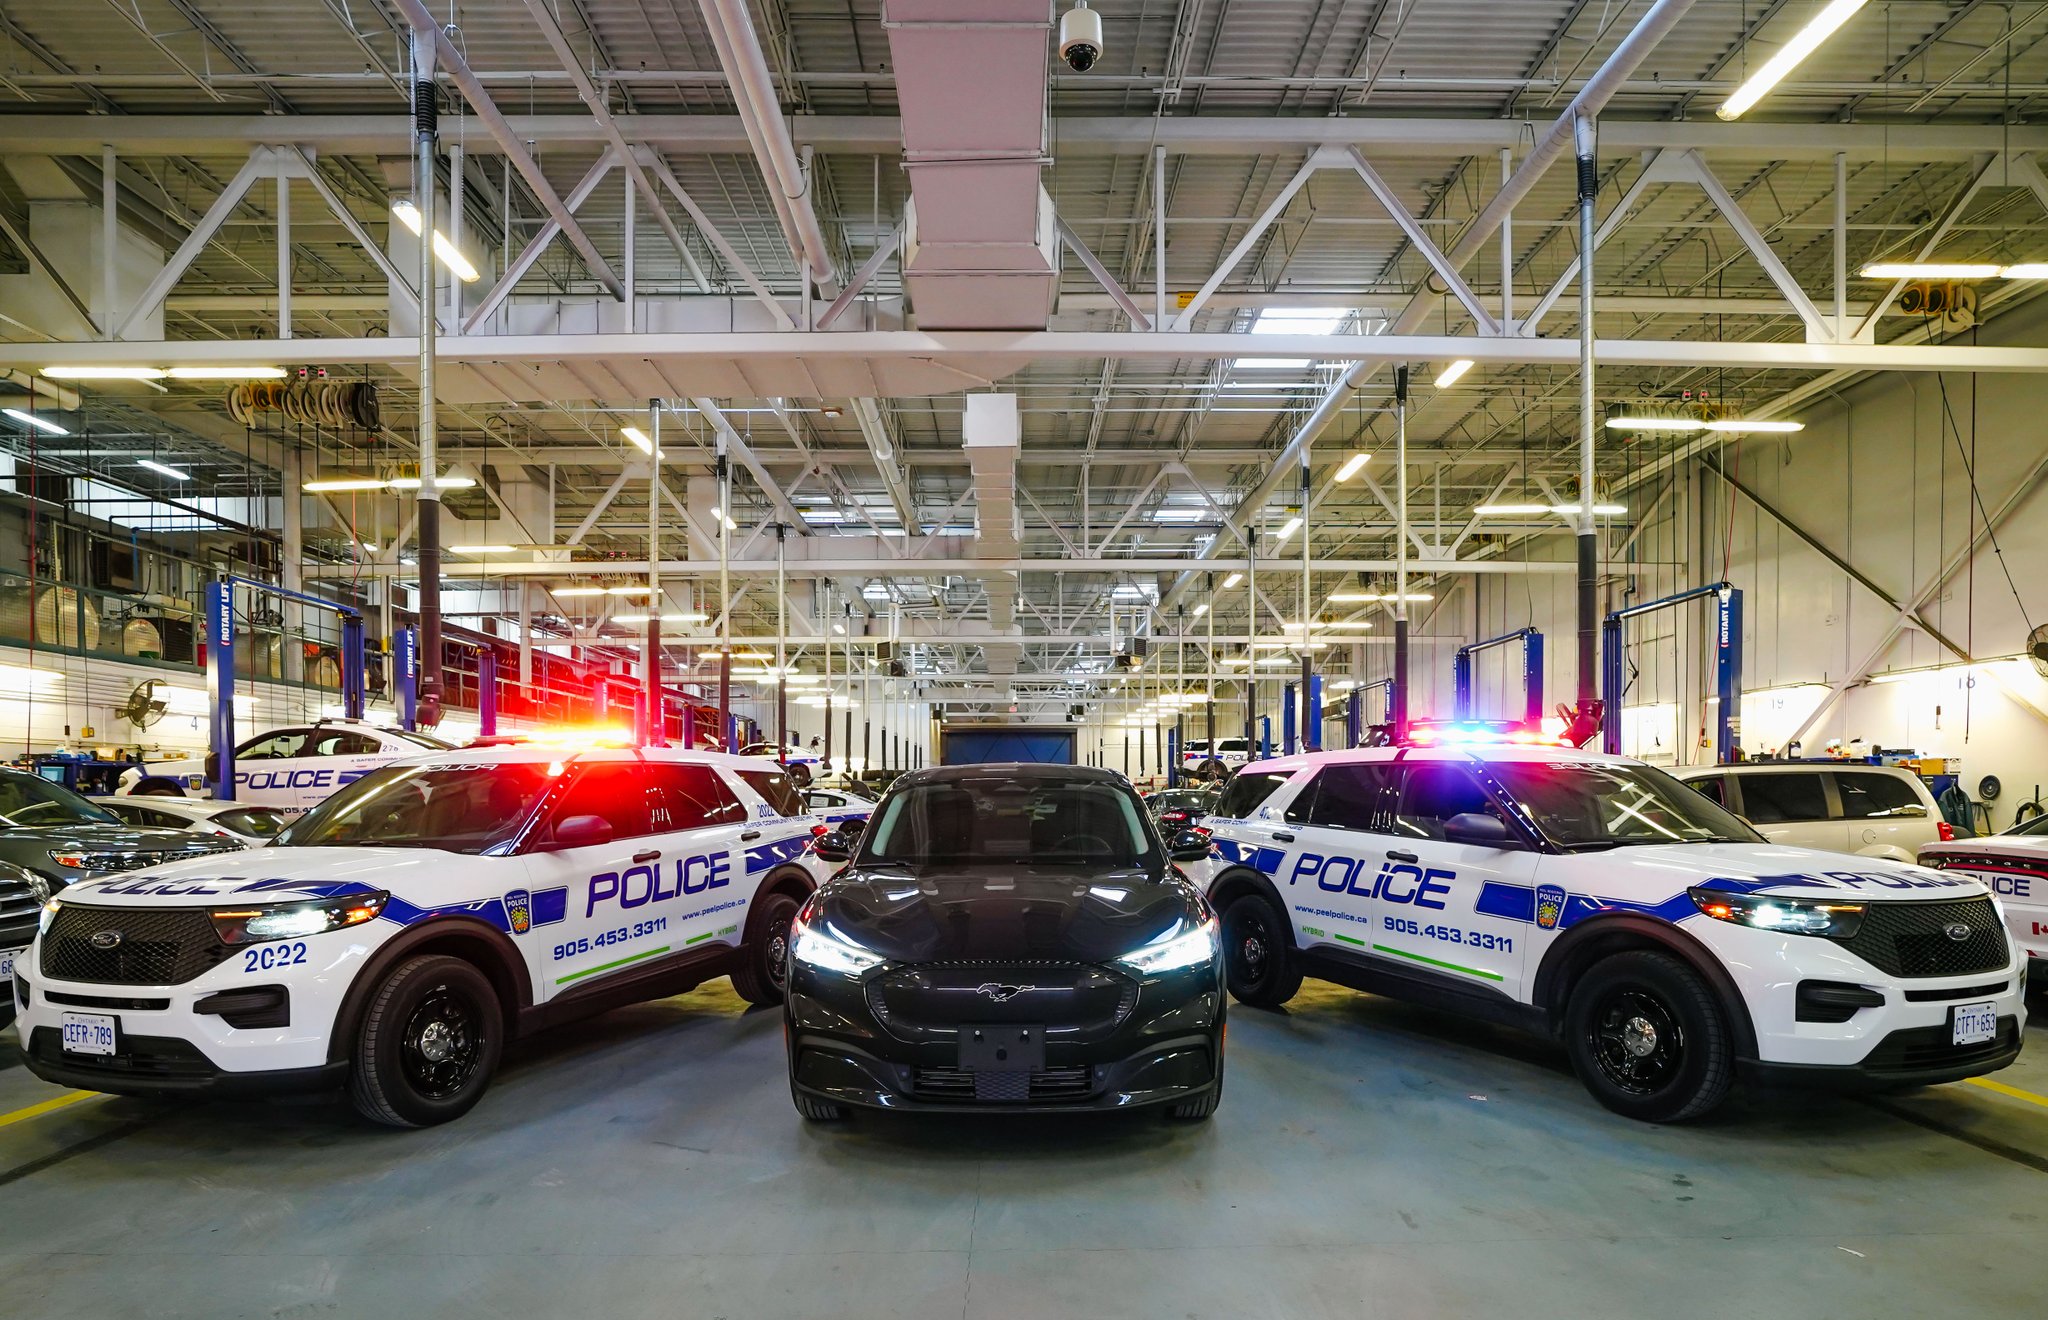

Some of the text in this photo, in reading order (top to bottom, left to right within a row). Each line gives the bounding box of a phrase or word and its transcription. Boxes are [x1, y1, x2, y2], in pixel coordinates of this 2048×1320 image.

[221, 583, 230, 641] ROTARY LIFT
[1721, 610, 1729, 643] ROTARY
[191, 716, 199, 730] 4
[586, 851, 731, 918] POLICE
[1289, 852, 1457, 910] POLICE
[507, 898, 528, 908] POLICE
[682, 898, 746, 920] www.peelpolice.ca
[1539, 892, 1563, 903] POLICE
[1294, 905, 1368, 924] www.peelpolice.ca
[553, 916, 667, 961] 905.453.3311
[717, 924, 738, 937] HYBRID
[1302, 925, 1325, 938] HYBRID
[1384, 916, 1513, 954] 905.453.3311
[244, 942, 307, 973] 2022
